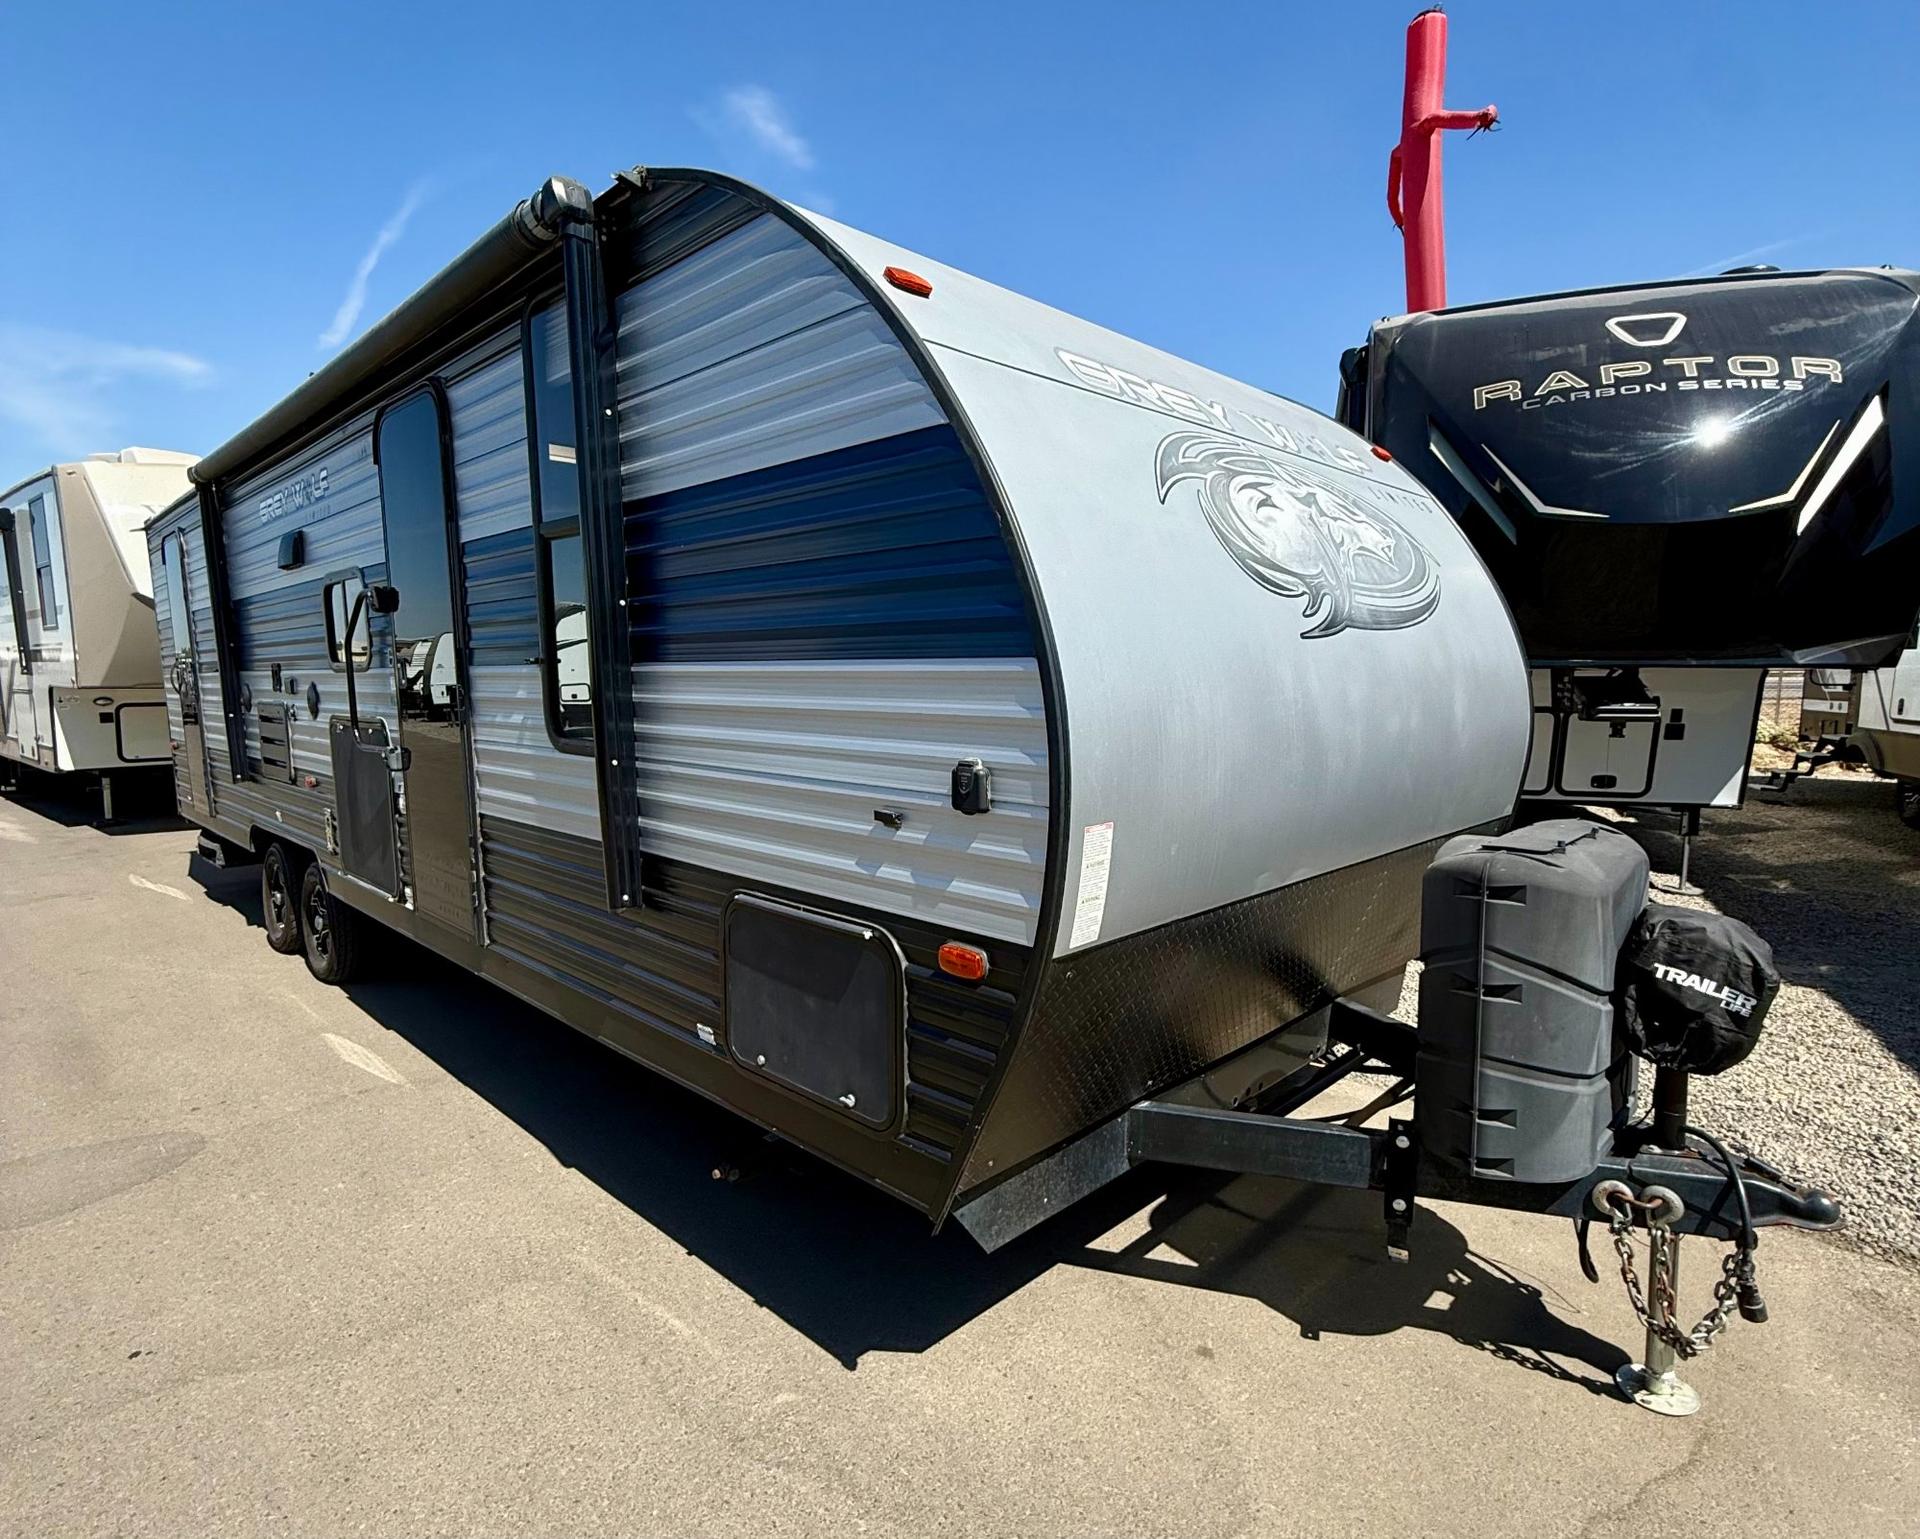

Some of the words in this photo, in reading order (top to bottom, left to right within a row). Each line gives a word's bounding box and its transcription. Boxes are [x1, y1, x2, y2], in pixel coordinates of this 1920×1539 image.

[1054, 346, 1236, 432] GREY
[1473, 354, 1843, 411] RAPTOR
[1521, 381, 1667, 411] CARBON
[1678, 378, 1804, 391] SERIES
[1653, 962, 1758, 1011] TRAILER
[1719, 1000, 1753, 1018] LIFE
